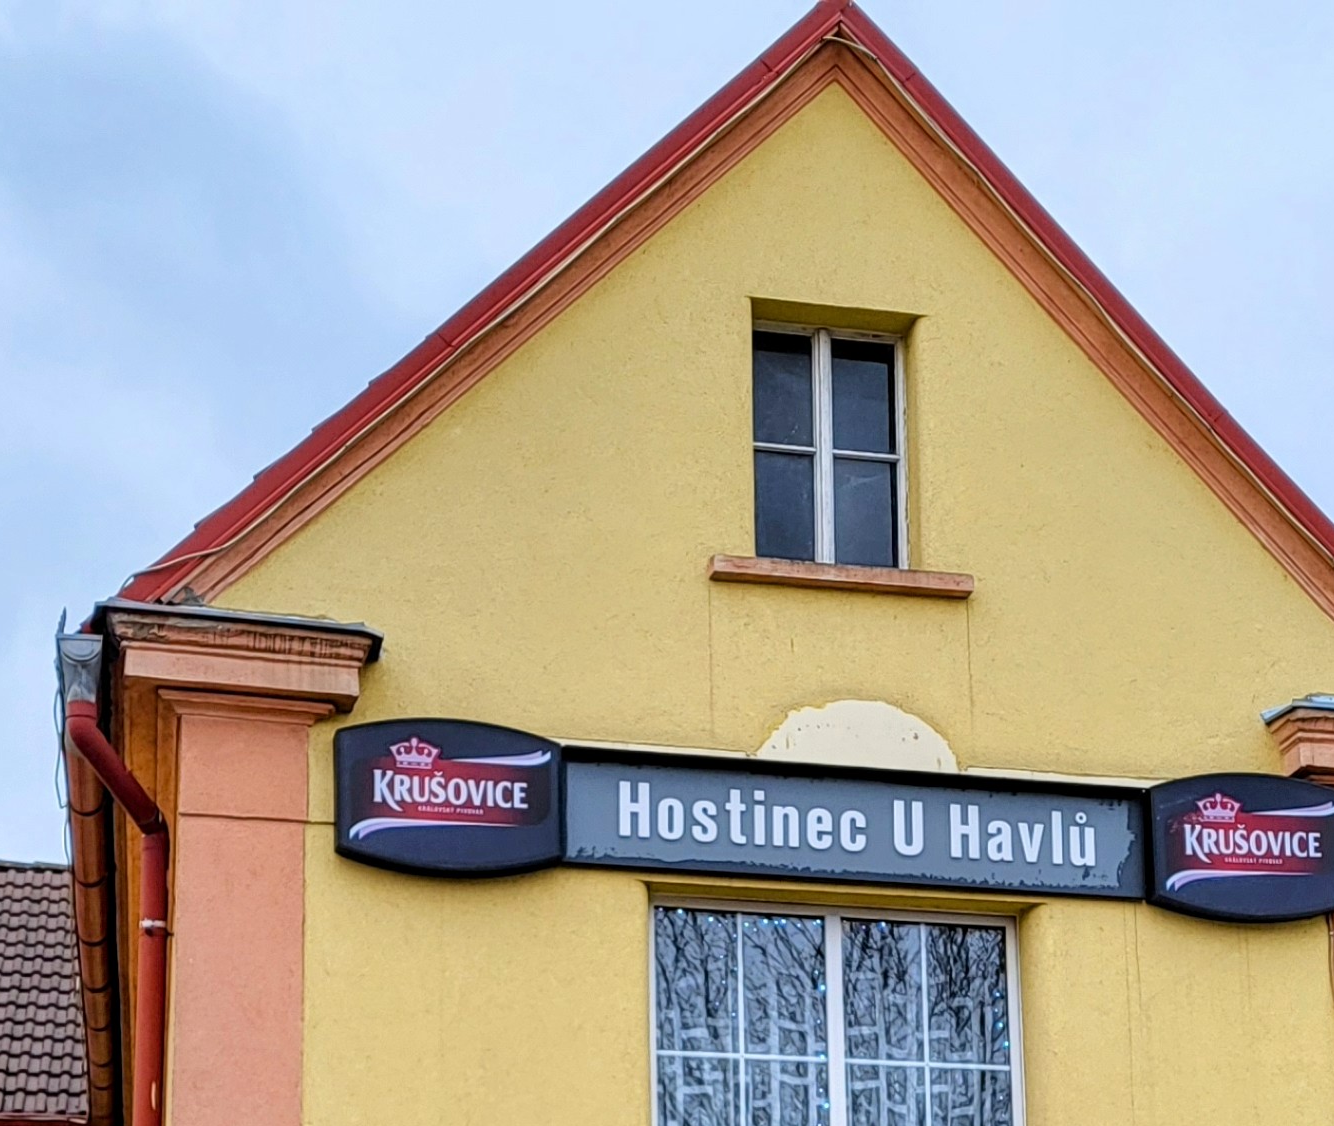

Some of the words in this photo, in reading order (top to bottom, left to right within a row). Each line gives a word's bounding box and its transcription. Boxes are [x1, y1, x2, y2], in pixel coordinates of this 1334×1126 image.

[372, 769, 529, 812] KRUŠOVICE
[618, 779, 867, 853] Hostinec
[892, 799, 925, 857] U
[949, 801, 1097, 868] Havlů
[1183, 824, 1323, 864] KRUŠOVICE
